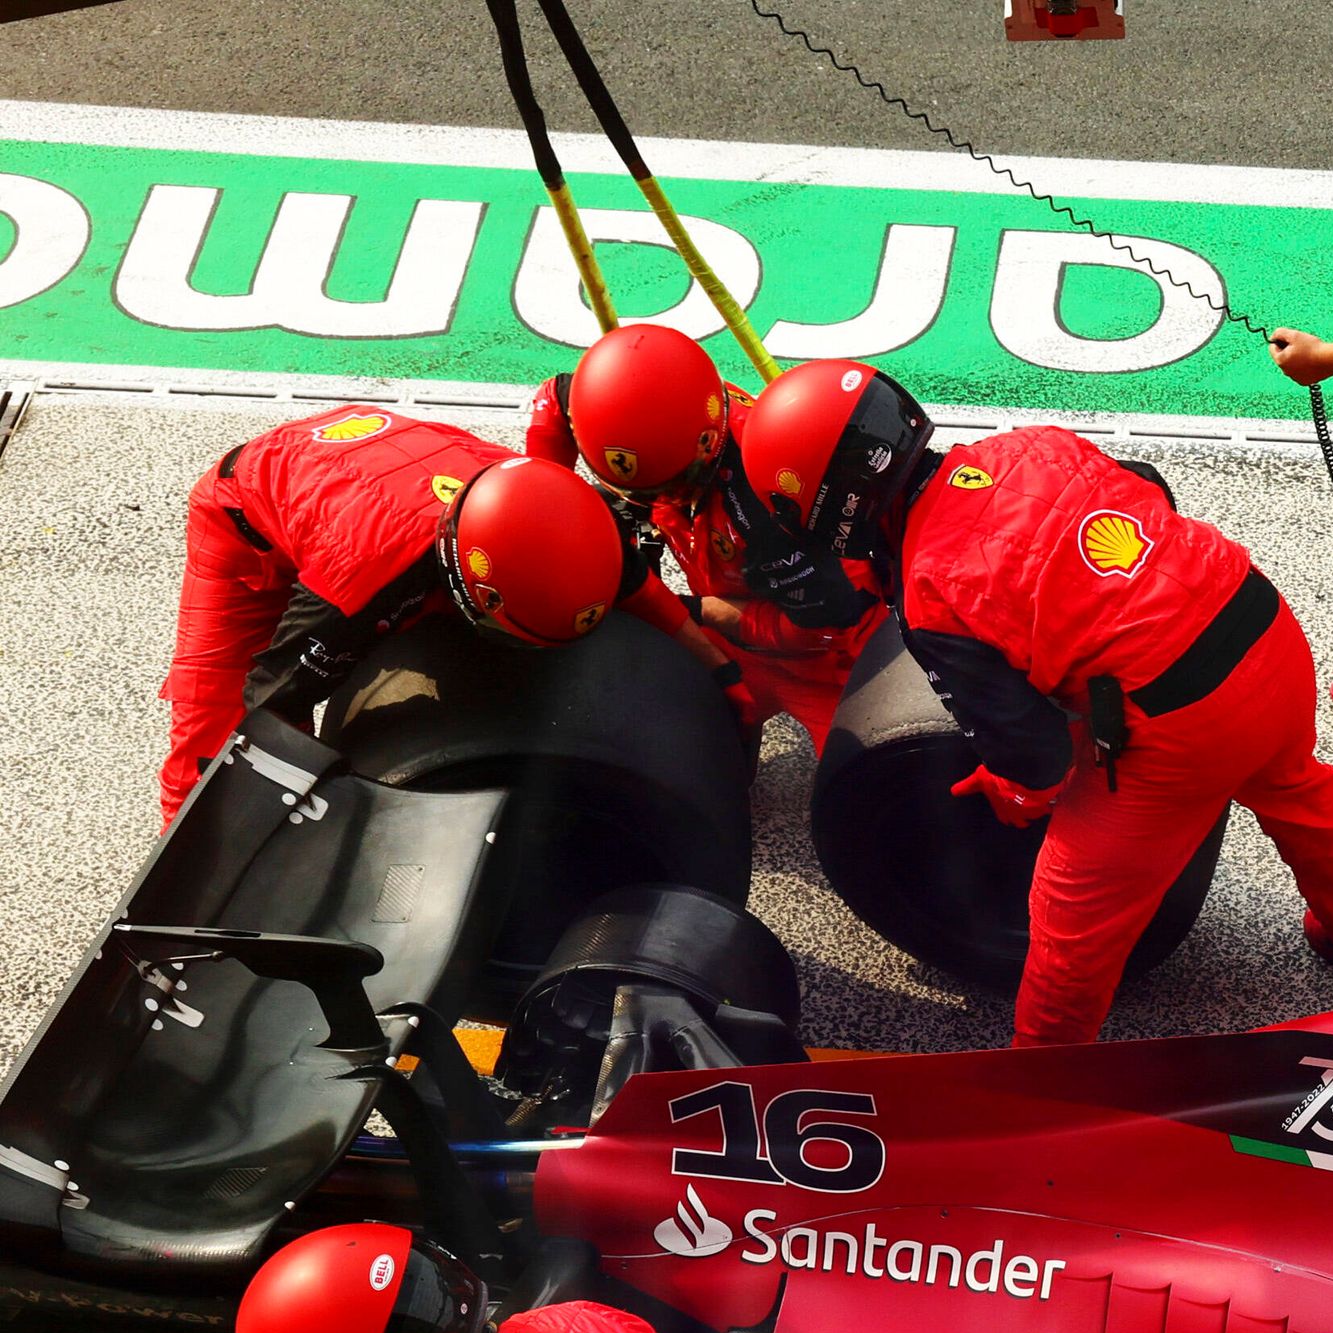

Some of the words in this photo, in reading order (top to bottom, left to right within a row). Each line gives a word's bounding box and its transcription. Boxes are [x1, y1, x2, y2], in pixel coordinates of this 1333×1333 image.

[667, 1080, 887, 1194] 16
[1281, 1082, 1326, 1130] 1947-2022
[374, 1259, 389, 1285] BELL
[741, 1207, 1067, 1299] Santander
